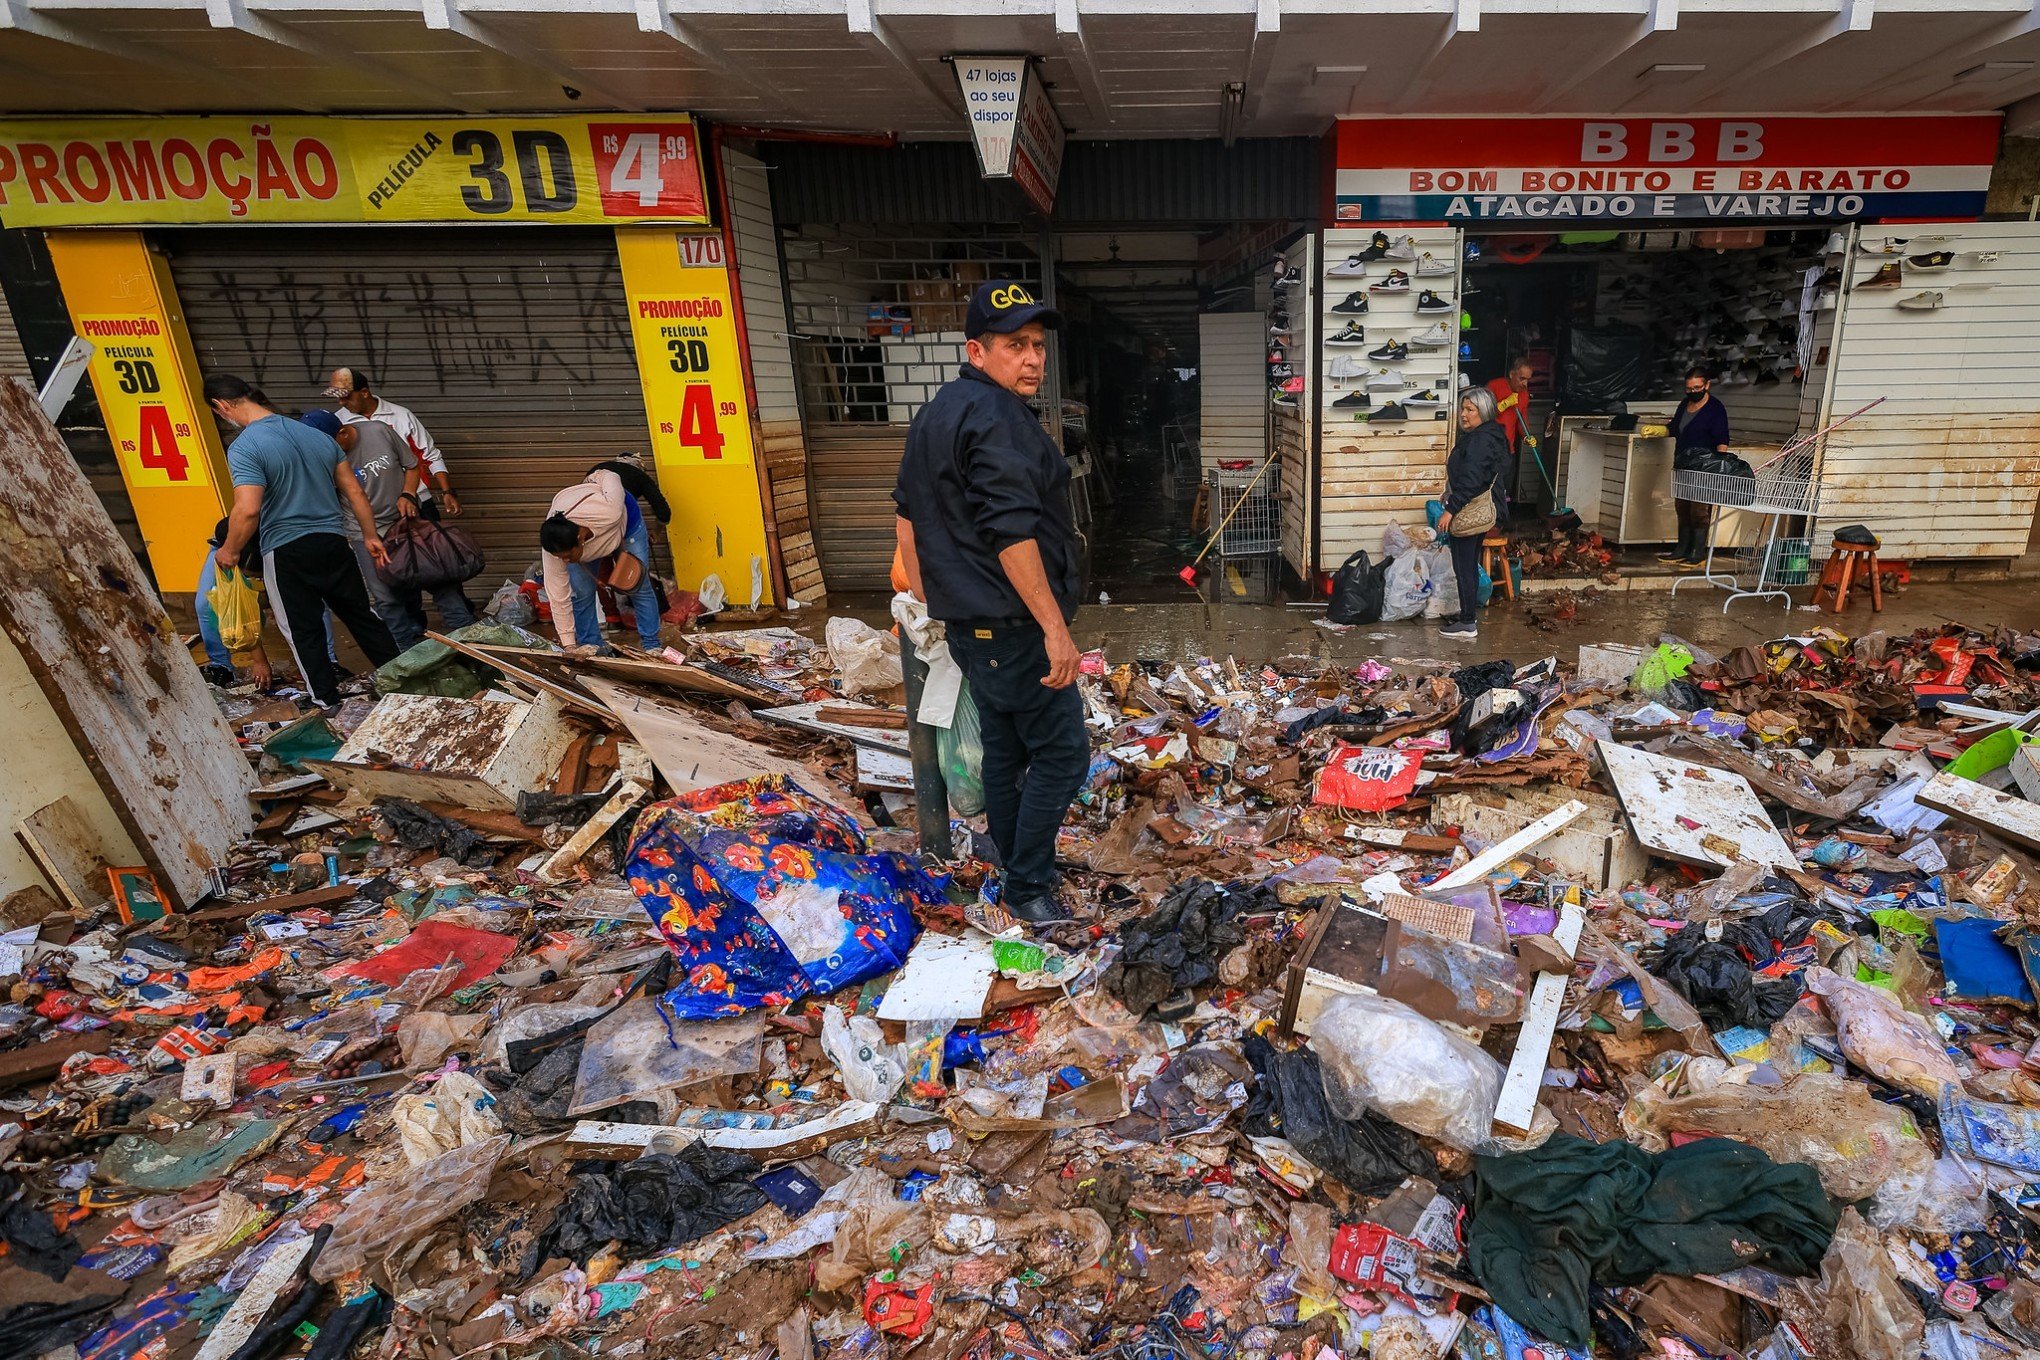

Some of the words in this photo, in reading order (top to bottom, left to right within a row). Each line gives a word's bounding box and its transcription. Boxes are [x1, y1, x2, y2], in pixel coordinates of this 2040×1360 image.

[966, 69, 981, 82] 47
[985, 69, 1017, 84] lojas
[970, 91, 988, 102] ao
[992, 91, 1015, 102] seu
[973, 109, 1014, 124] dispor
[603, 134, 619, 155] R$
[983, 137, 1009, 165] 170
[367, 131, 443, 210] PELÍCULA
[452, 129, 578, 215] 3D
[1409, 171, 1498, 192] BOM
[1522, 171, 1671, 192] BONITO
[1693, 170, 1717, 191] E
[1738, 169, 1911, 191] BARATO
[1445, 196, 1636, 217] ATACADO
[1653, 195, 1676, 216] E
[1703, 195, 1864, 216] VAREJO
[679, 236, 722, 264] 170
[638, 297, 723, 321] PROMOÇÃO
[82, 317, 160, 339] PROMOÇÃO
[661, 325, 709, 338] PELÍCULA
[104, 345, 155, 358] PELÍCULA
[668, 339, 710, 373] 3D
[114, 360, 161, 394] 3D
[660, 422, 674, 434] R$
[121, 440, 136, 452] R$
